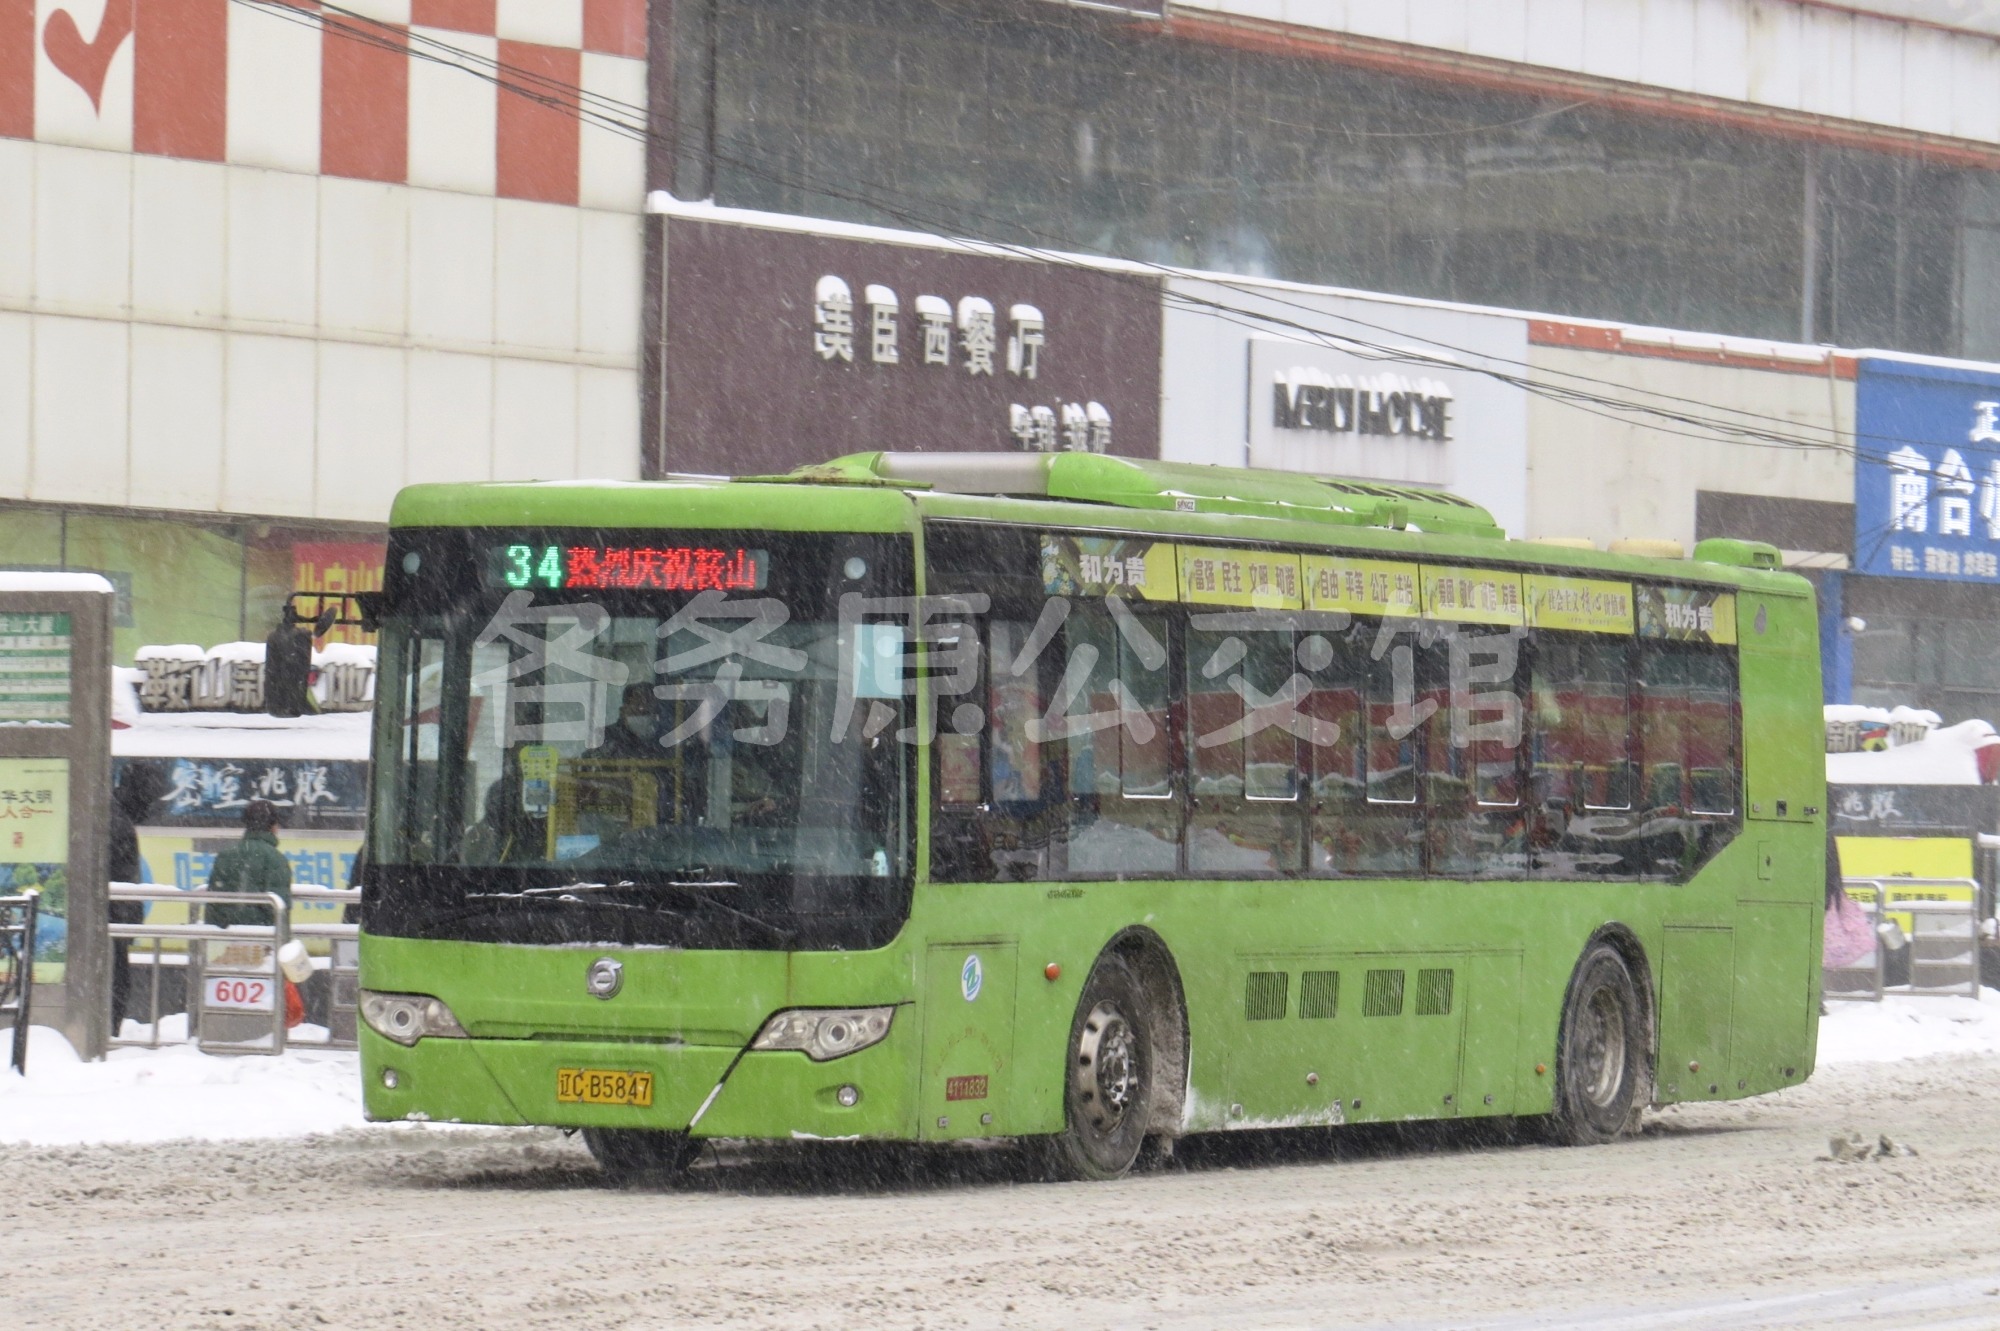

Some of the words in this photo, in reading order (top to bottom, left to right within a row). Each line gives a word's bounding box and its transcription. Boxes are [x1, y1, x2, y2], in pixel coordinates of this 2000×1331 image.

[506, 545, 562, 588] 34
[1079, 553, 1146, 586] 和为贵
[1193, 557, 1215, 591] 富强
[1222, 560, 1242, 593] 民主
[1248, 562, 1268, 595] 文明
[1320, 567, 1339, 599] 自由
[1345, 570, 1364, 602] 平等
[1370, 572, 1389, 603] 公正
[1664, 602, 1714, 632] 和为贵
[0, 789, 53, 804] 华文明
[0, 805, 53, 819] 人合一
[215, 980, 265, 1004] 602
